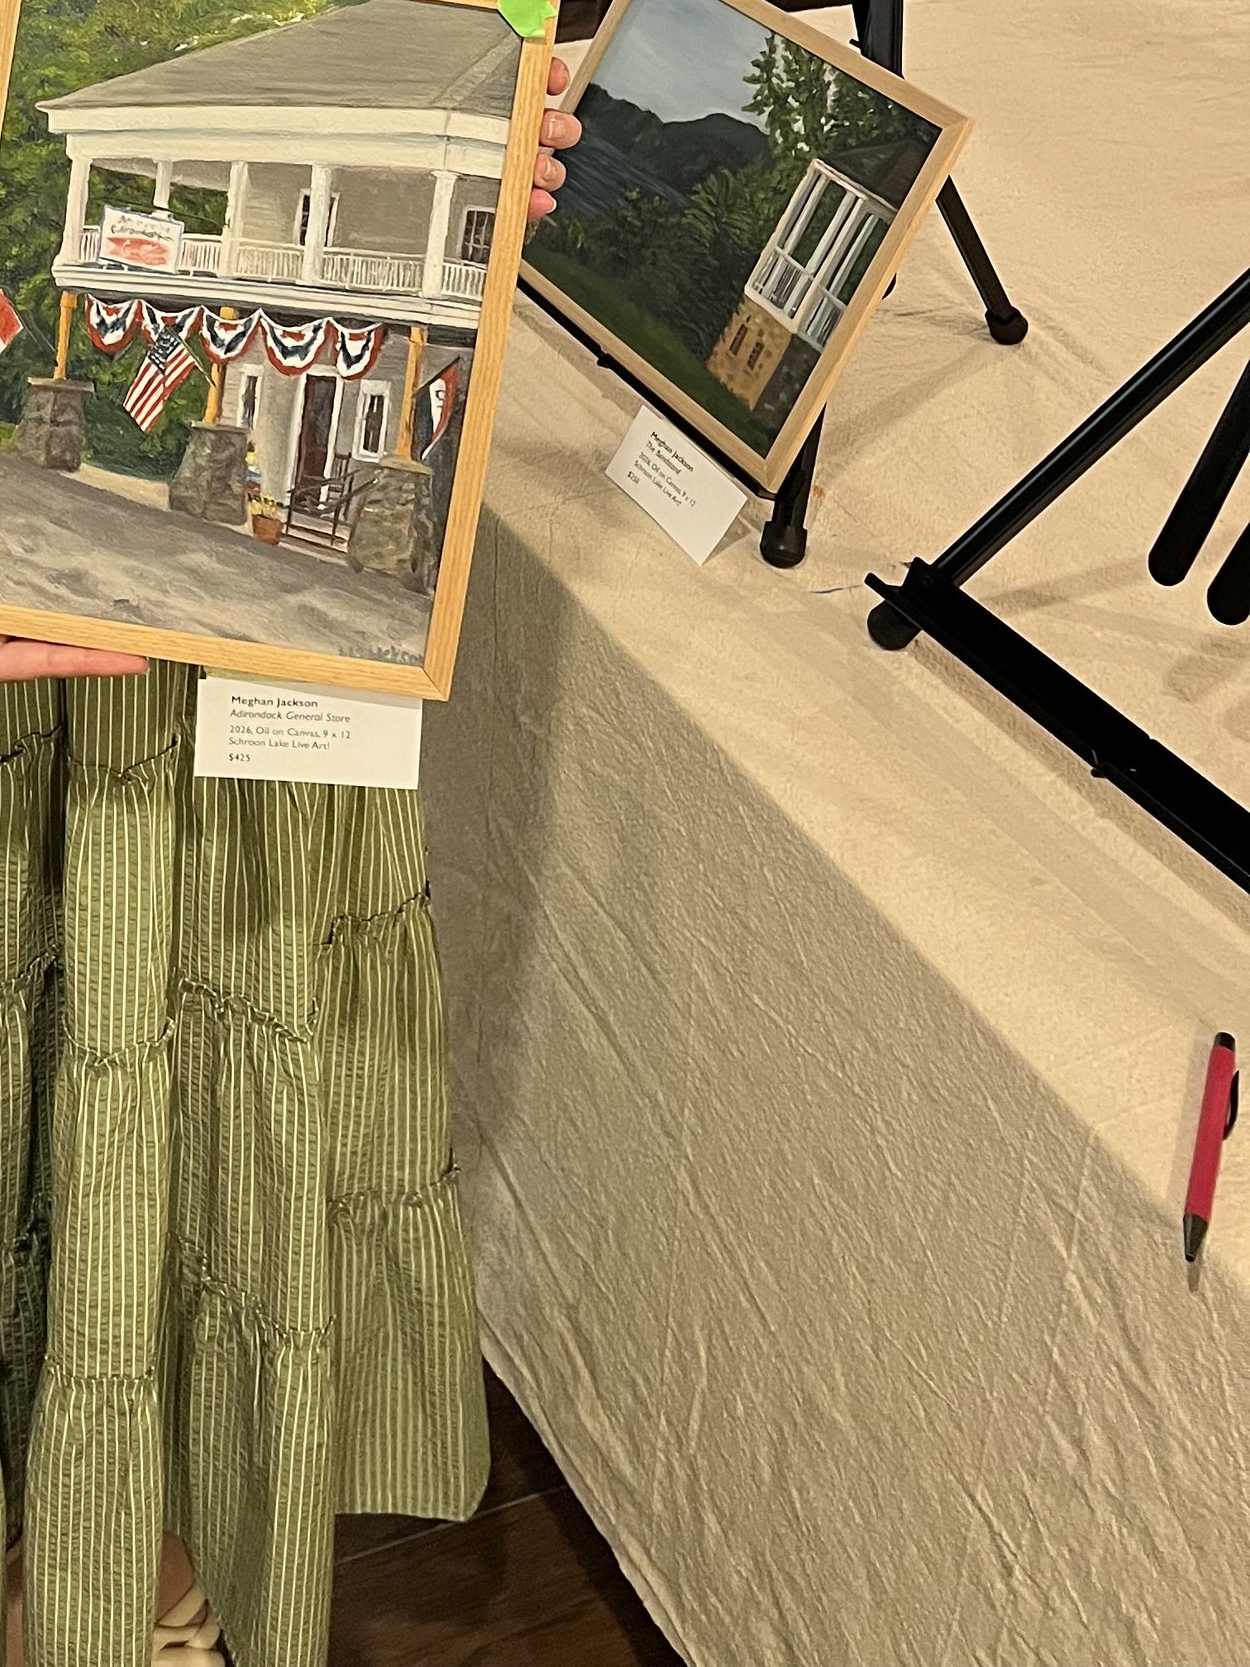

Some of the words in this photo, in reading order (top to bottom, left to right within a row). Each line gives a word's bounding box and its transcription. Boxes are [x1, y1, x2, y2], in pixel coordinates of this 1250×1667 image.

[231, 695, 274, 708] Meghan
[276, 697, 318, 708] Jackson
[229, 708, 283, 720] Adirondack
[285, 710, 324, 722] General
[325, 712, 351, 724] Store
[229, 724, 254, 735] 2026,
[255, 725, 270, 735] Oil
[271, 727, 284, 735] on
[322, 729, 329, 738] 9
[341, 730, 351, 740] 12
[228, 736, 266, 746] Schroon
[268, 738, 290, 748] Lake
[291, 739, 310, 749] Live
[311, 741, 331, 751] Art!
[228, 752, 251, 762] $425
